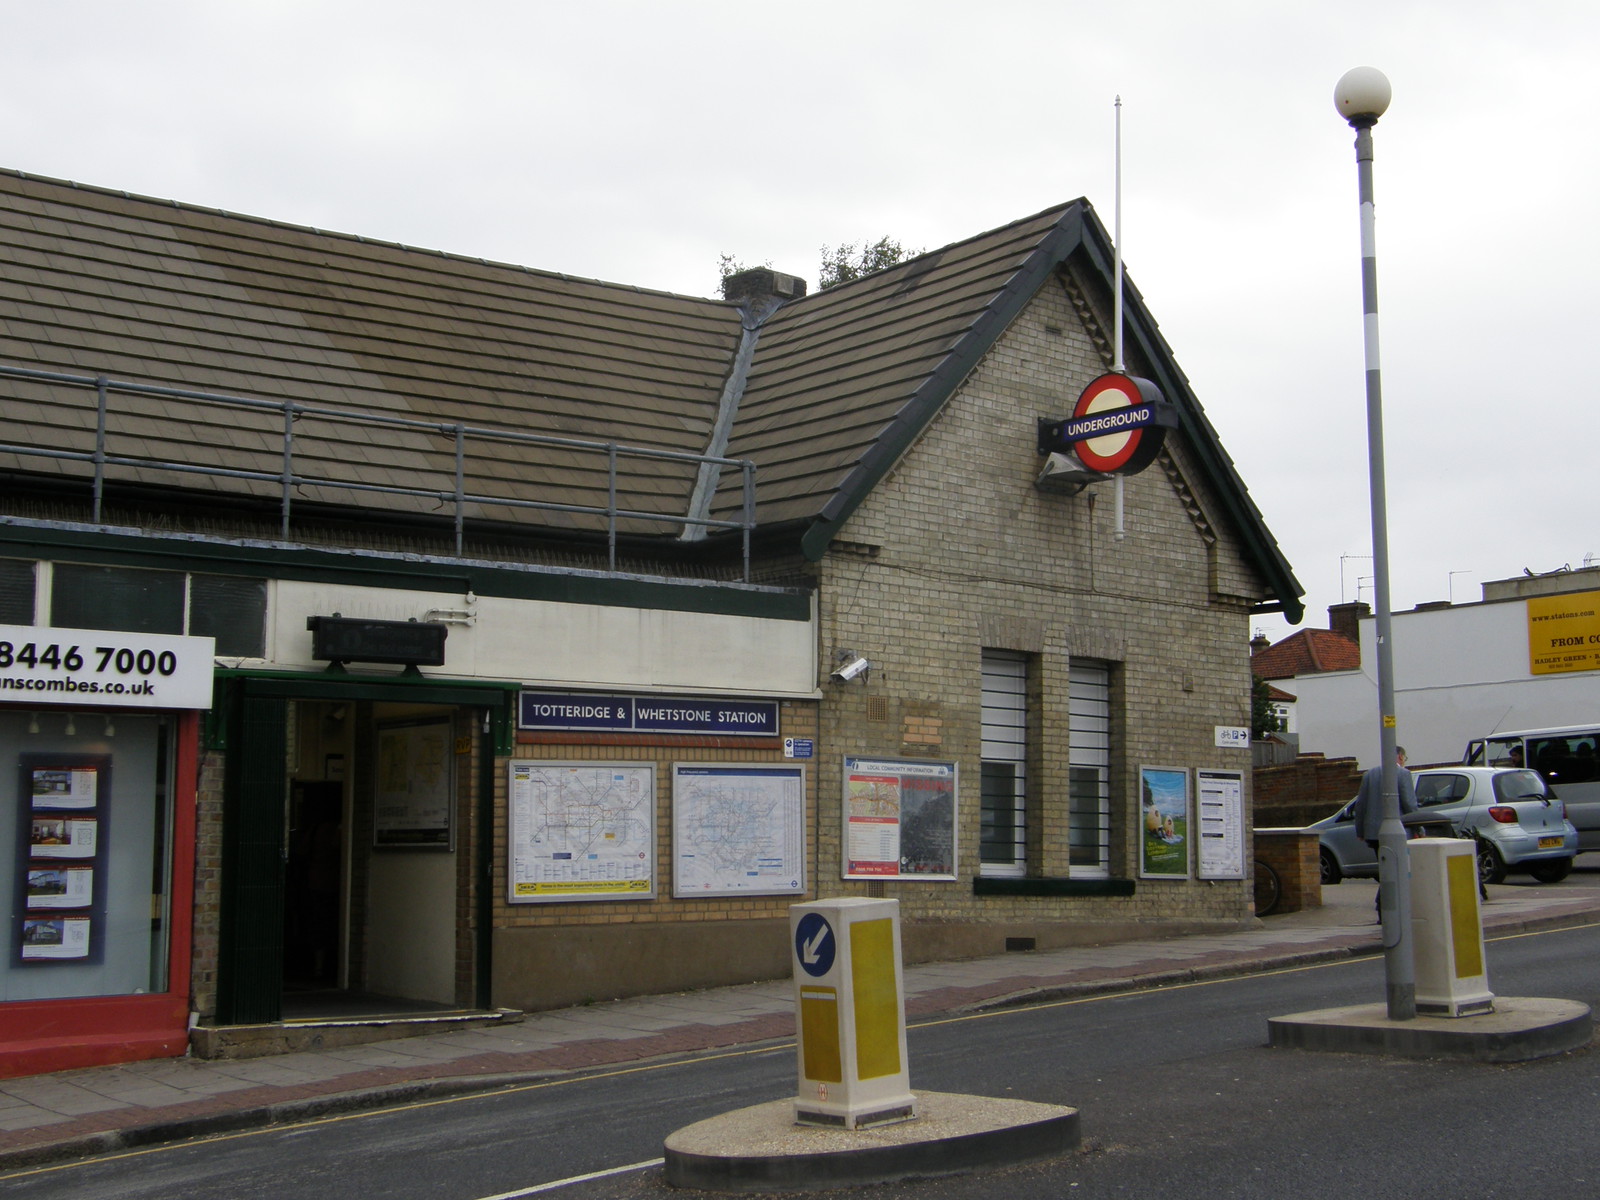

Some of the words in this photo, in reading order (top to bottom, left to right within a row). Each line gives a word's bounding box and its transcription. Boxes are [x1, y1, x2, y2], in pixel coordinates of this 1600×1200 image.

[1068, 409, 1150, 436] UNDERGROUND
[1551, 637, 1584, 647] FROM
[0, 641, 84, 671] 8446
[95, 647, 177, 676] 7000
[0, 676, 155, 696] nscombes.co.uk
[533, 704, 611, 719] TOTTERIDGE
[616, 707, 626, 719] &
[637, 708, 712, 722] WHETSTONE
[718, 711, 766, 724] STATION
[901, 778, 953, 791] MISSING
